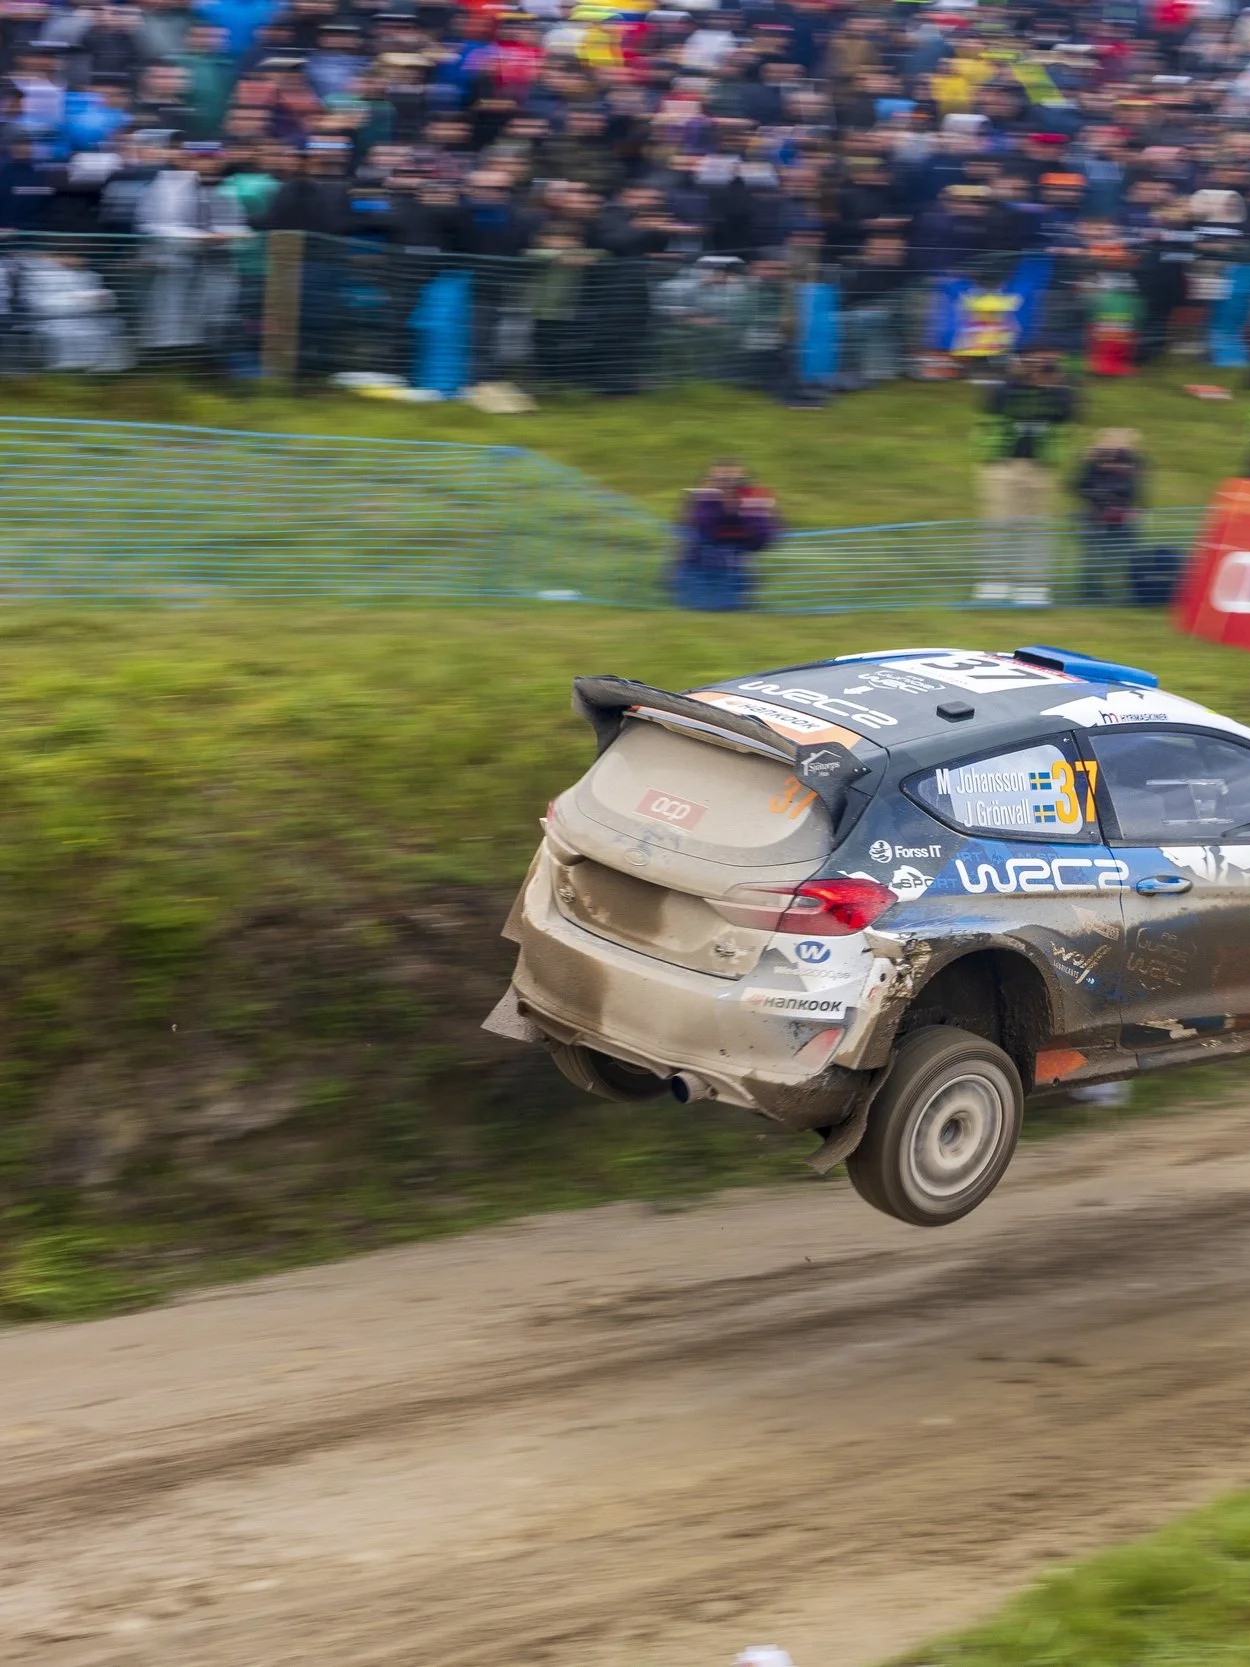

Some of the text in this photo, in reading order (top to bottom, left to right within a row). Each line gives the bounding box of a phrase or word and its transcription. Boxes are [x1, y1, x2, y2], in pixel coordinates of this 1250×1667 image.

[936, 767, 1027, 795] M Johansson
[1051, 760, 1098, 825] 37
[964, 799, 1032, 828] J Grönvall
[895, 845, 929, 858] Forss
[930, 844, 942, 857] IT
[955, 858, 1130, 894] WRC2
